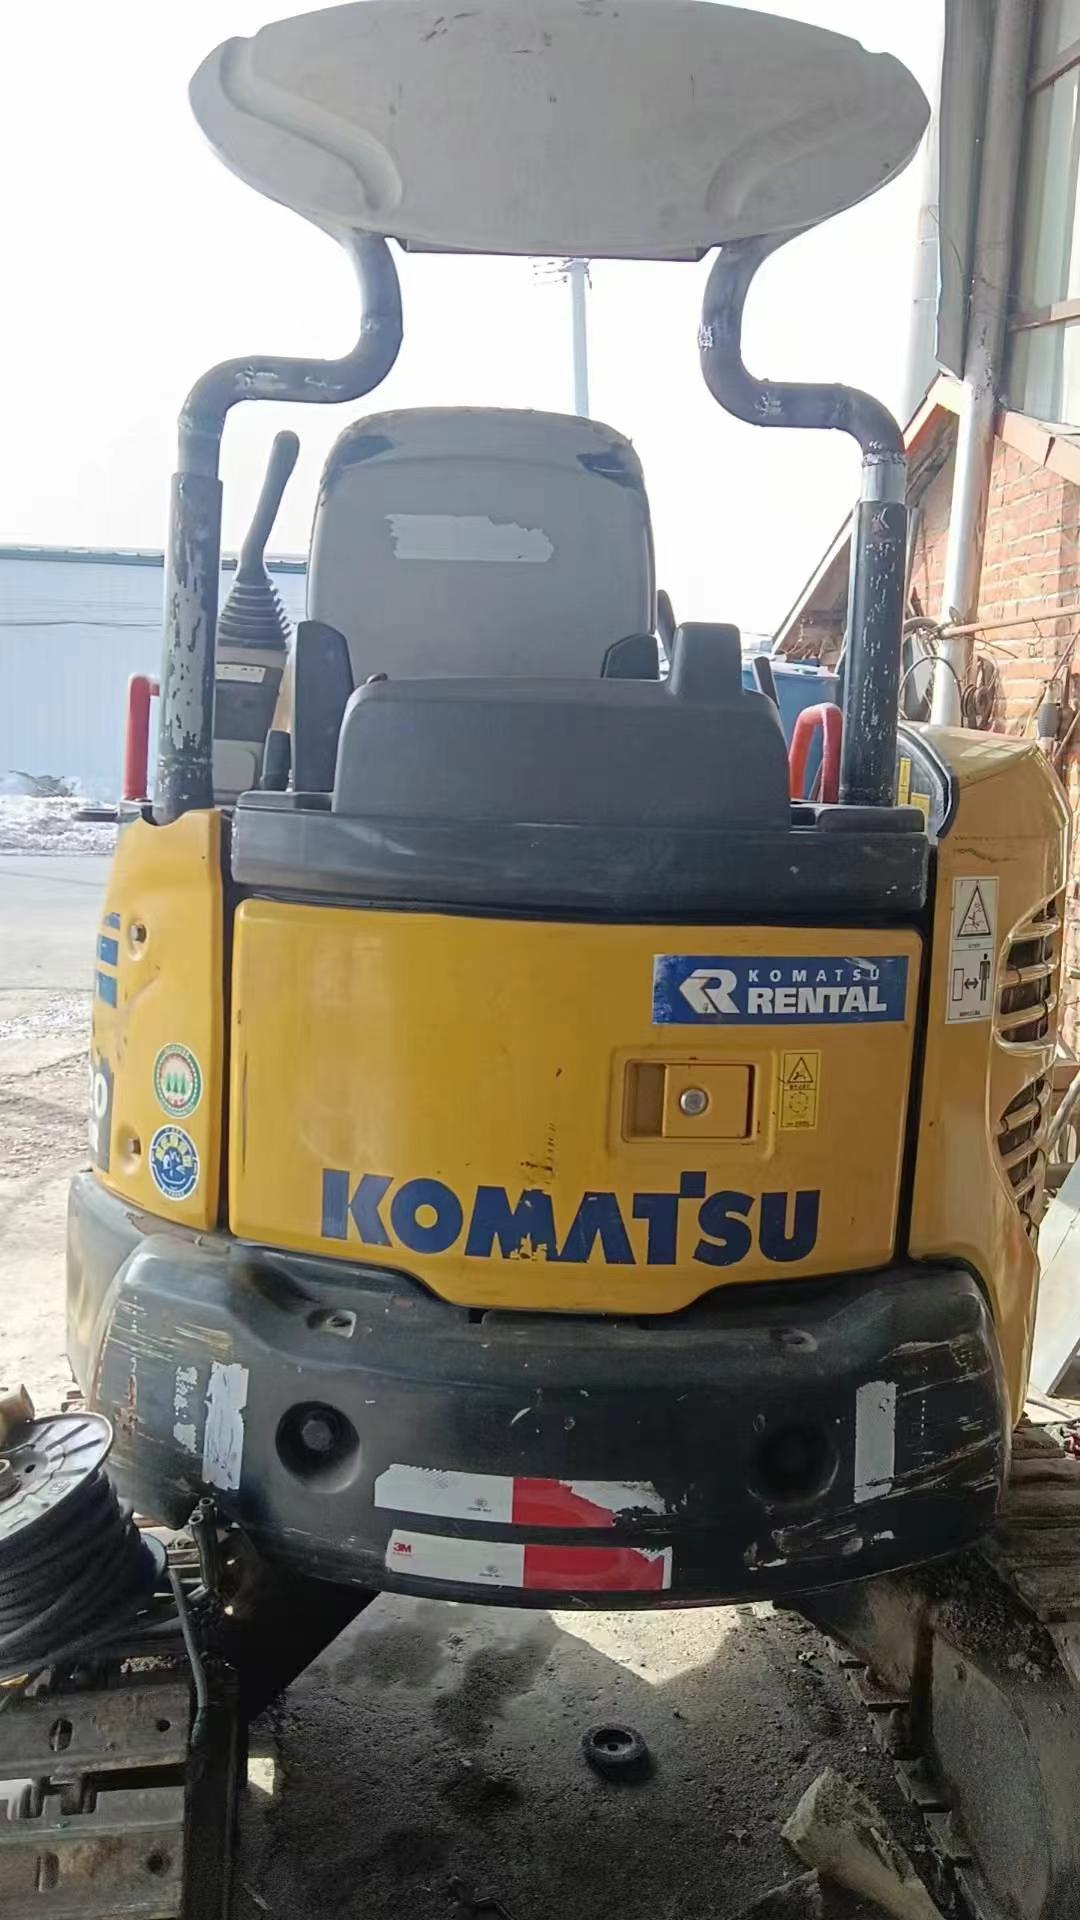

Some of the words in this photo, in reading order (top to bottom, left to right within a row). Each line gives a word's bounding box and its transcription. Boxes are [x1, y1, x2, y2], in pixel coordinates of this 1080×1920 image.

[748, 968, 880, 982] KOMATSU
[747, 986, 887, 1014] RENTAL
[321, 1167, 820, 1266] KOMATSU
[393, 1542, 412, 1552] 3M
